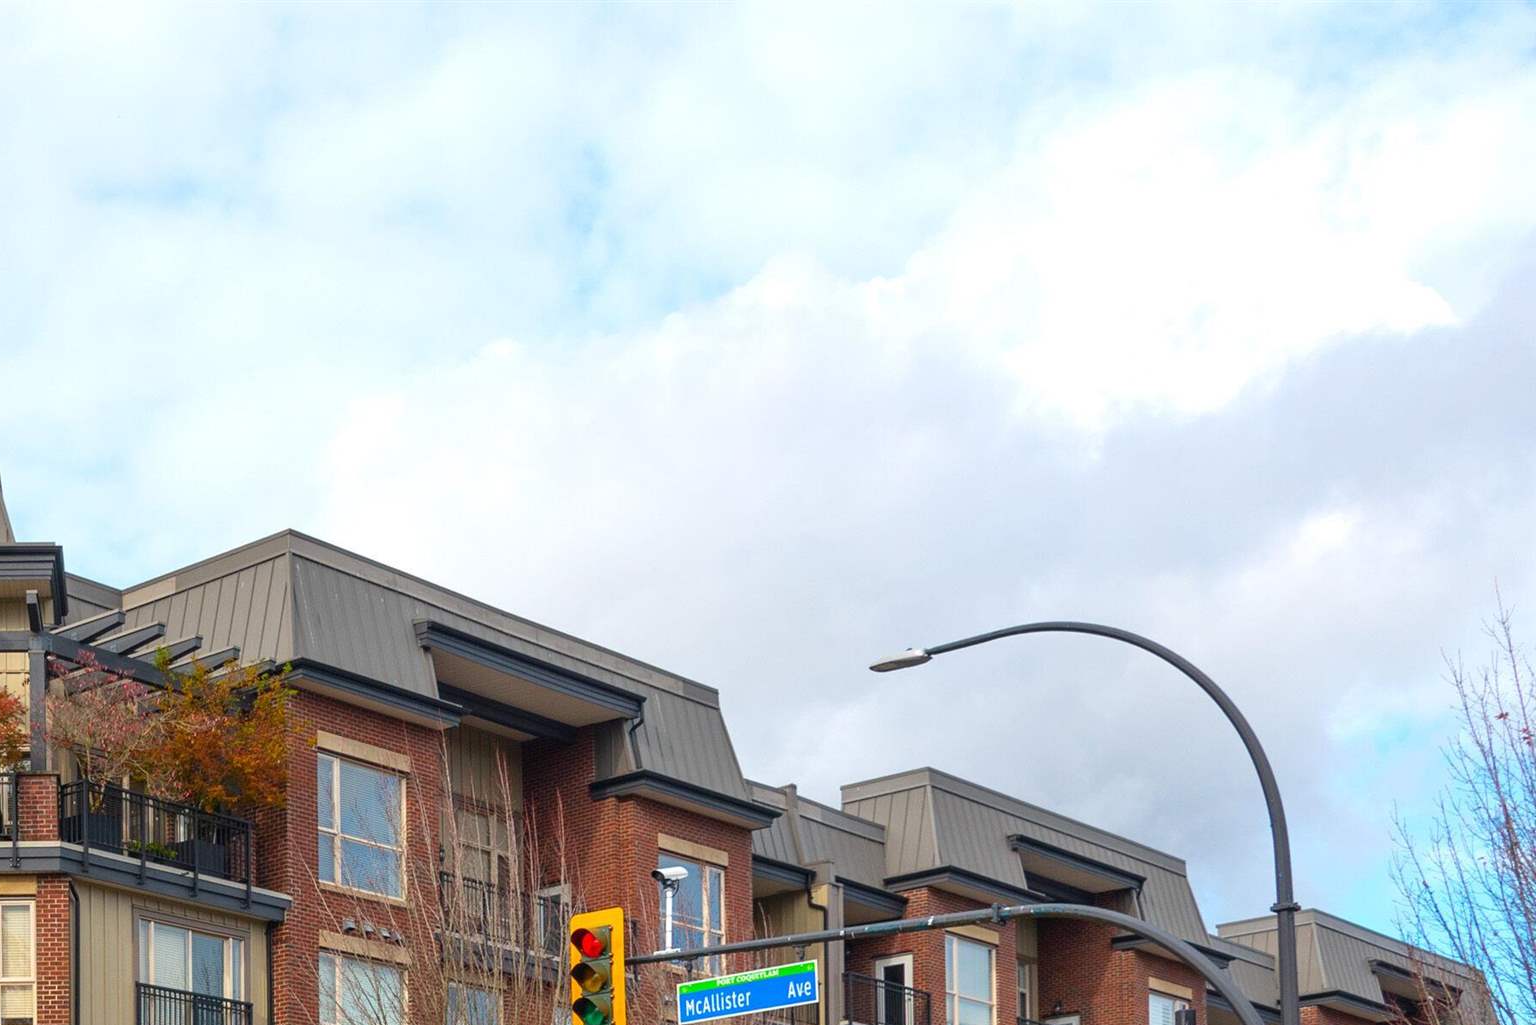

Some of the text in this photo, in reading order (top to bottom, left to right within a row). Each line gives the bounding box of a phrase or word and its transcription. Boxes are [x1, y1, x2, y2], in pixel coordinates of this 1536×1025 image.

[716, 968, 779, 987] PORT COQUITLAM
[685, 981, 812, 1016] McAllister Ave
